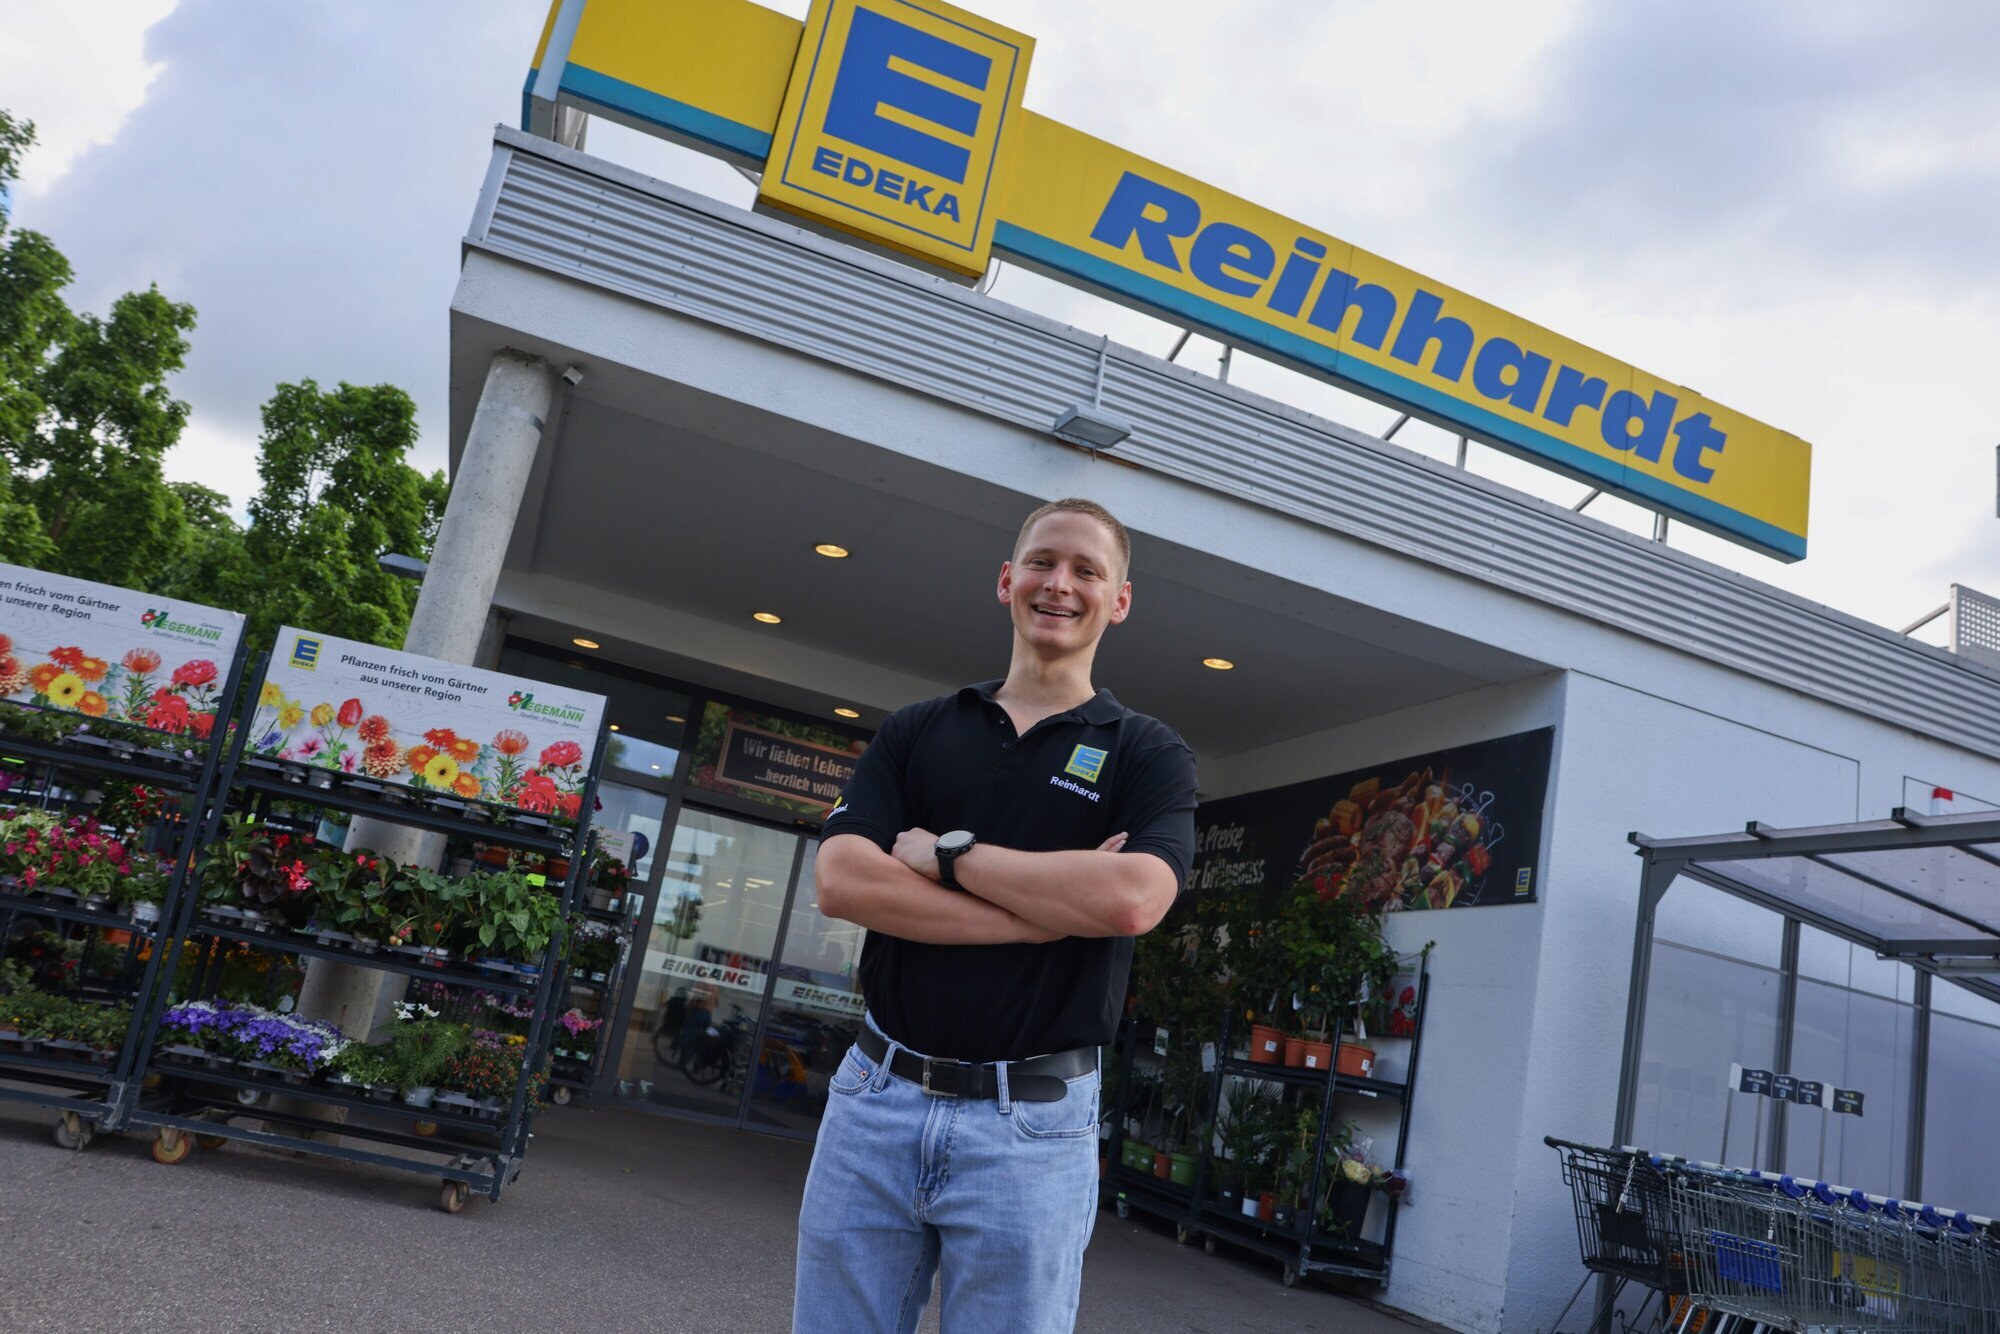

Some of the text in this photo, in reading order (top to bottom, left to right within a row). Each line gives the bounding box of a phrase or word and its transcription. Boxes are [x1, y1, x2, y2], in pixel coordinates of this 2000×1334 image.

[822, 5, 993, 185] E
[811, 145, 961, 223] EDEKA
[1089, 170, 1728, 484] Reinhardt
[6, 597, 49, 611] unserer
[51, 604, 91, 620] Region
[15, 582, 46, 597] frisch
[50, 592, 74, 602] vom
[77, 596, 120, 612] Gärtner
[141, 608, 222, 641] HEGEMANN
[294, 638, 319, 661] E
[341, 654, 489, 695] Pflanzen frisch vom Gärtner
[360, 674, 462, 702] aus unserer Region
[508, 690, 584, 722] HEGEMANN
[744, 738, 768, 759] Wir
[769, 745, 811, 770] lieben
[1073, 746, 1103, 772] E
[1050, 776, 1100, 802] Reinhardt
[1205, 821, 1245, 853] Preise,
[662, 958, 751, 986] EINGANG
[792, 985, 867, 1010] EINGAN
